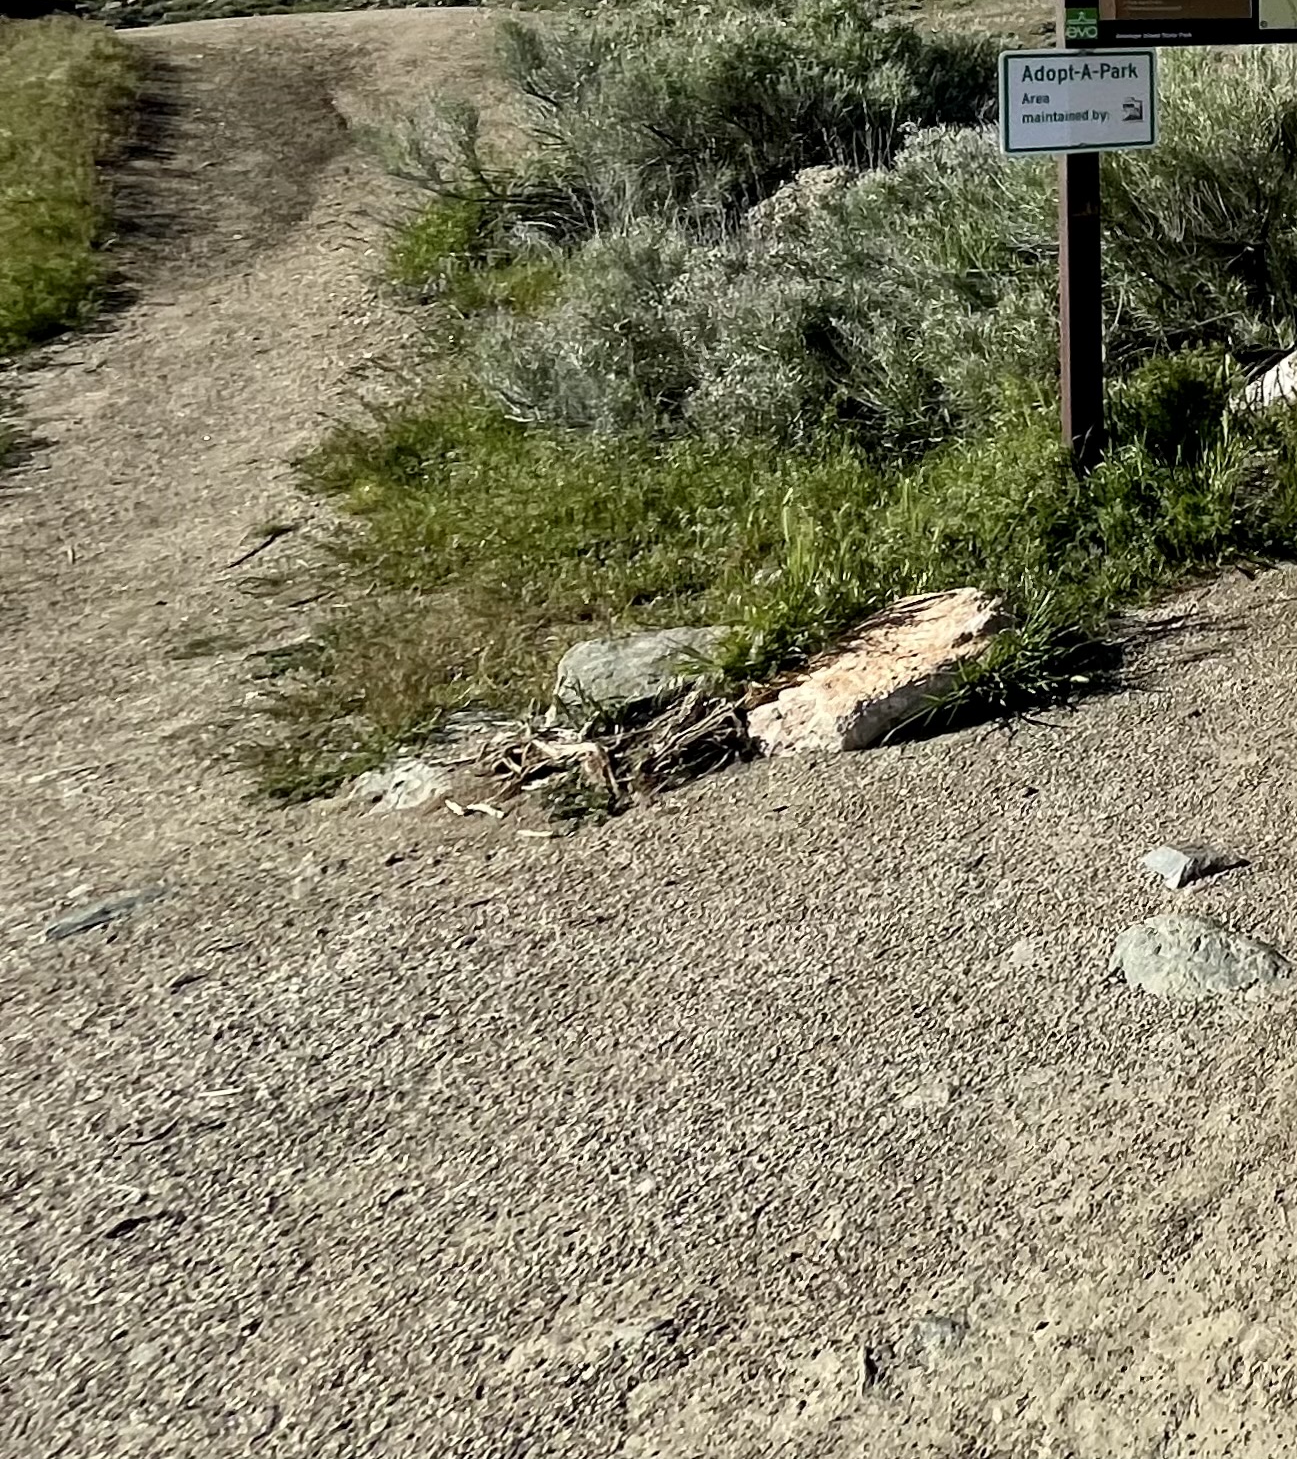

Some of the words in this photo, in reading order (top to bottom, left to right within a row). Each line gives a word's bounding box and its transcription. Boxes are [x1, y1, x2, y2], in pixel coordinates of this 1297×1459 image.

[1066, 26, 1098, 39] evo
[1021, 63, 1139, 85] Adopt-A-Park
[1021, 92, 1050, 104] Area
[1021, 109, 1089, 124] maintained
